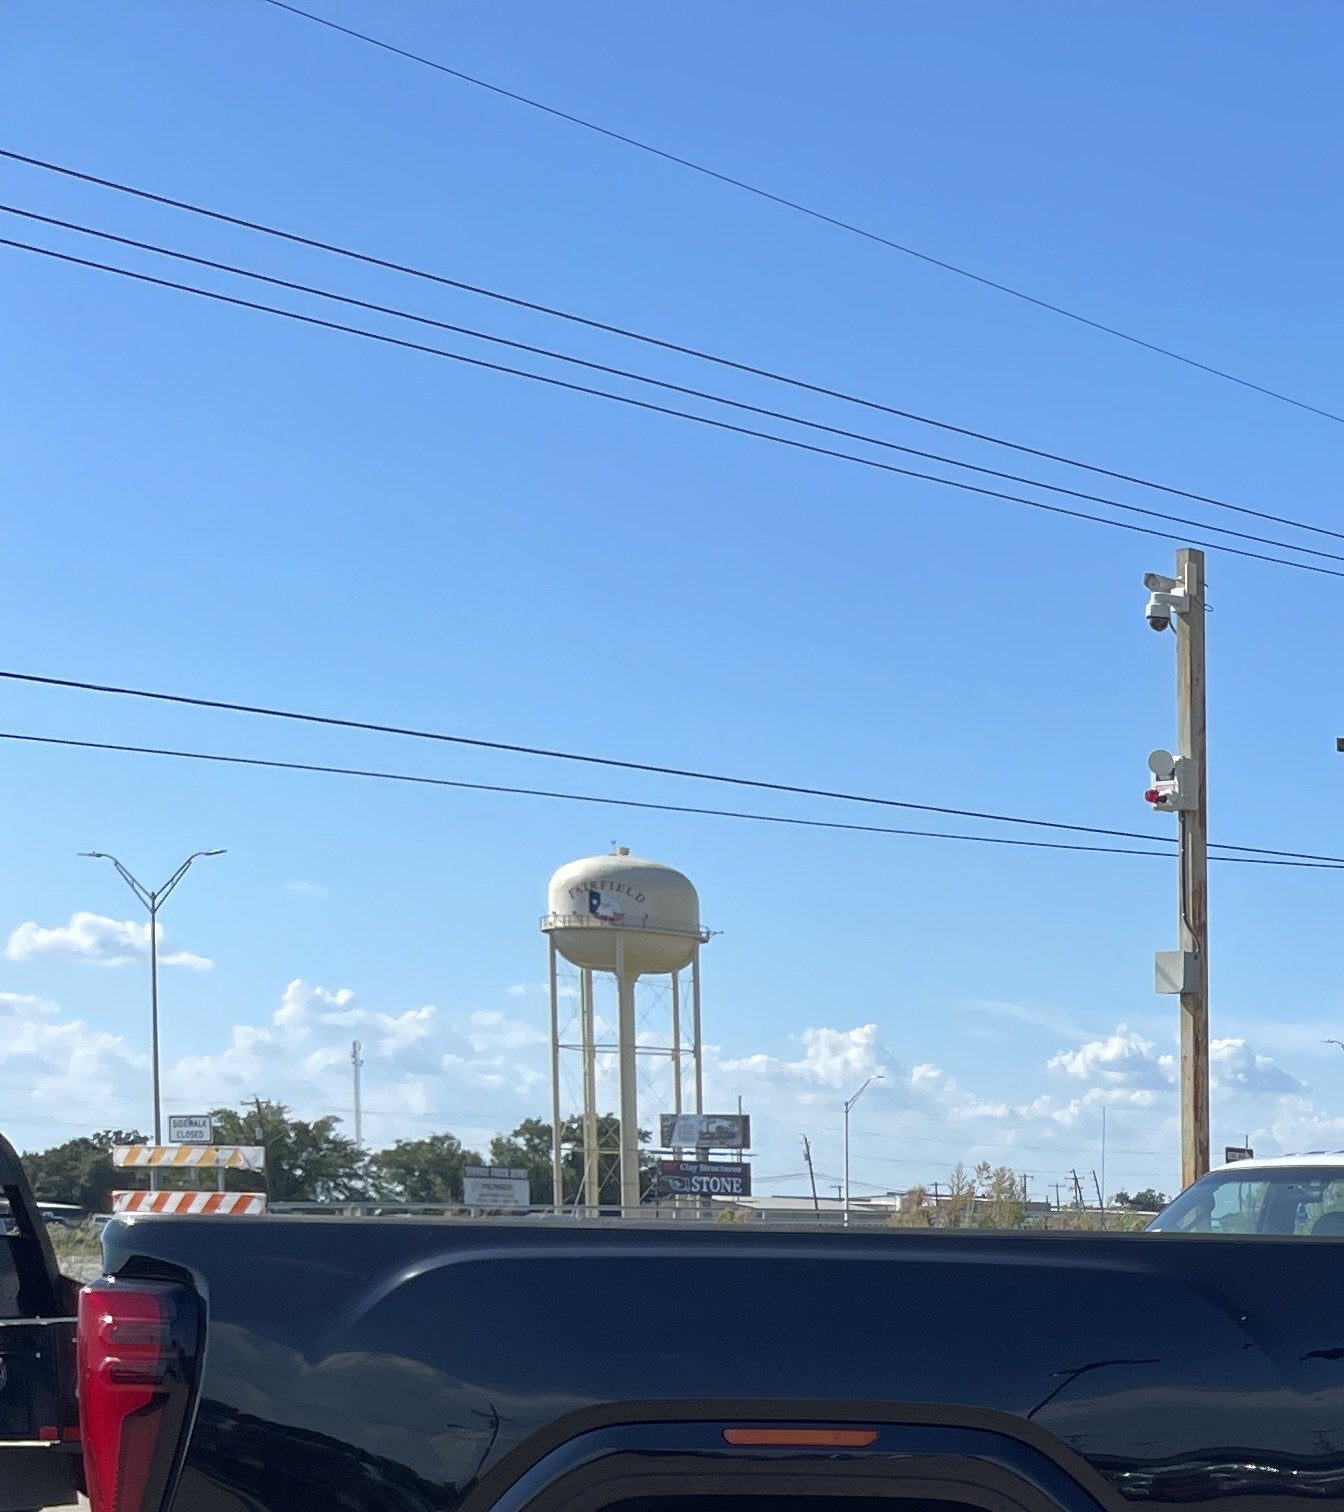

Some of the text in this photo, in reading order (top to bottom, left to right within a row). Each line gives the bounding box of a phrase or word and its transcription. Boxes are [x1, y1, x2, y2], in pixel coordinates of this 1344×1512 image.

[568, 880, 646, 903] FAIRFIELD
[176, 1130, 205, 1139] CLOSED
[691, 1176, 743, 1193] STONE
